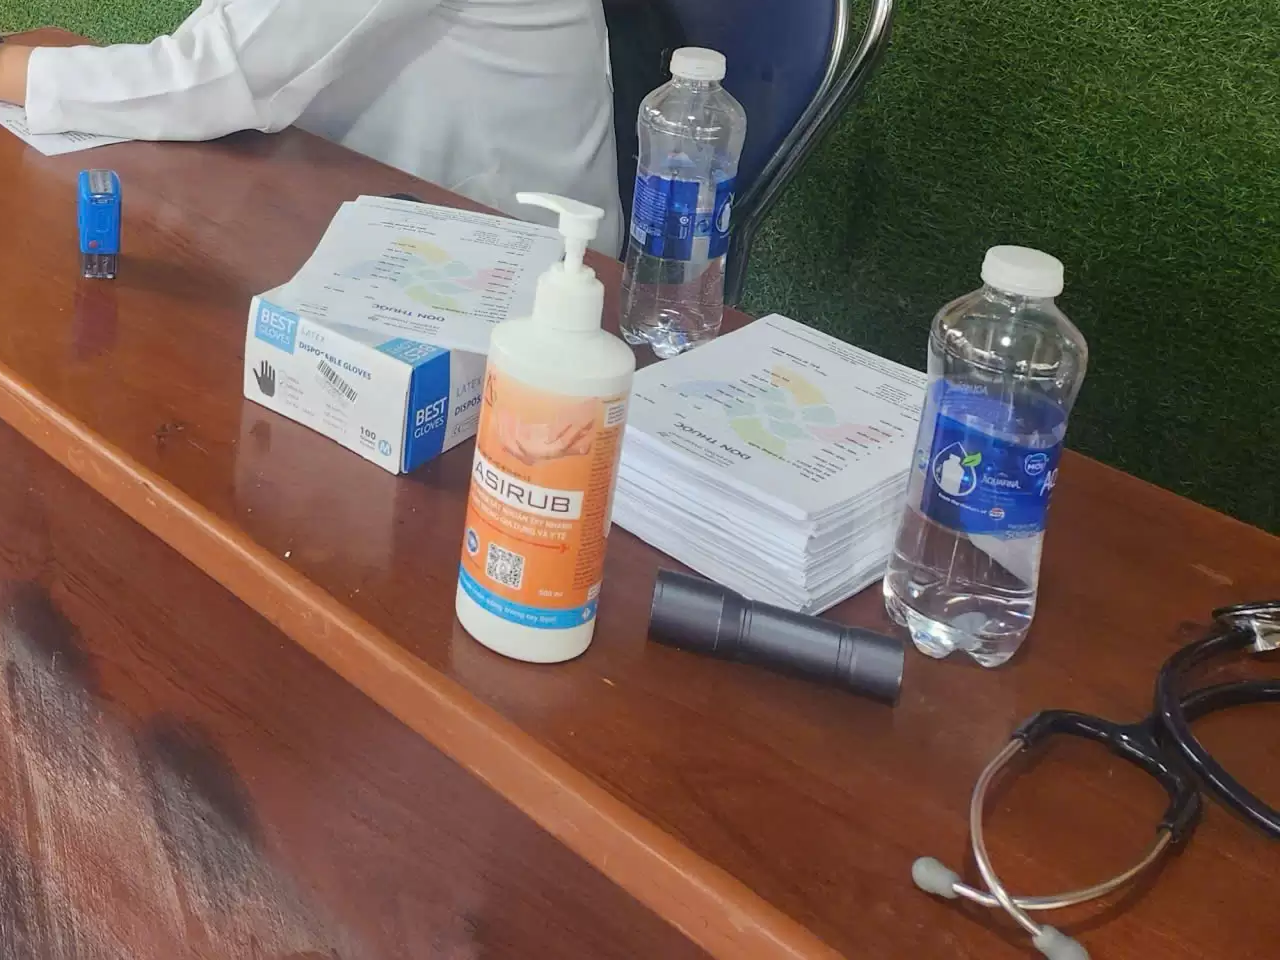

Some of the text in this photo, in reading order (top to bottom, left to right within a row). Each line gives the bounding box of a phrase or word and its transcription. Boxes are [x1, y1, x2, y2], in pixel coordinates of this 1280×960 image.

[260, 307, 297, 334] BEST
[342, 361, 373, 382] GLOVES
[414, 395, 448, 428] BEST
[360, 425, 377, 441] 100
[413, 415, 445, 440] GLOVES
[474, 460, 571, 513] ASIRUB
